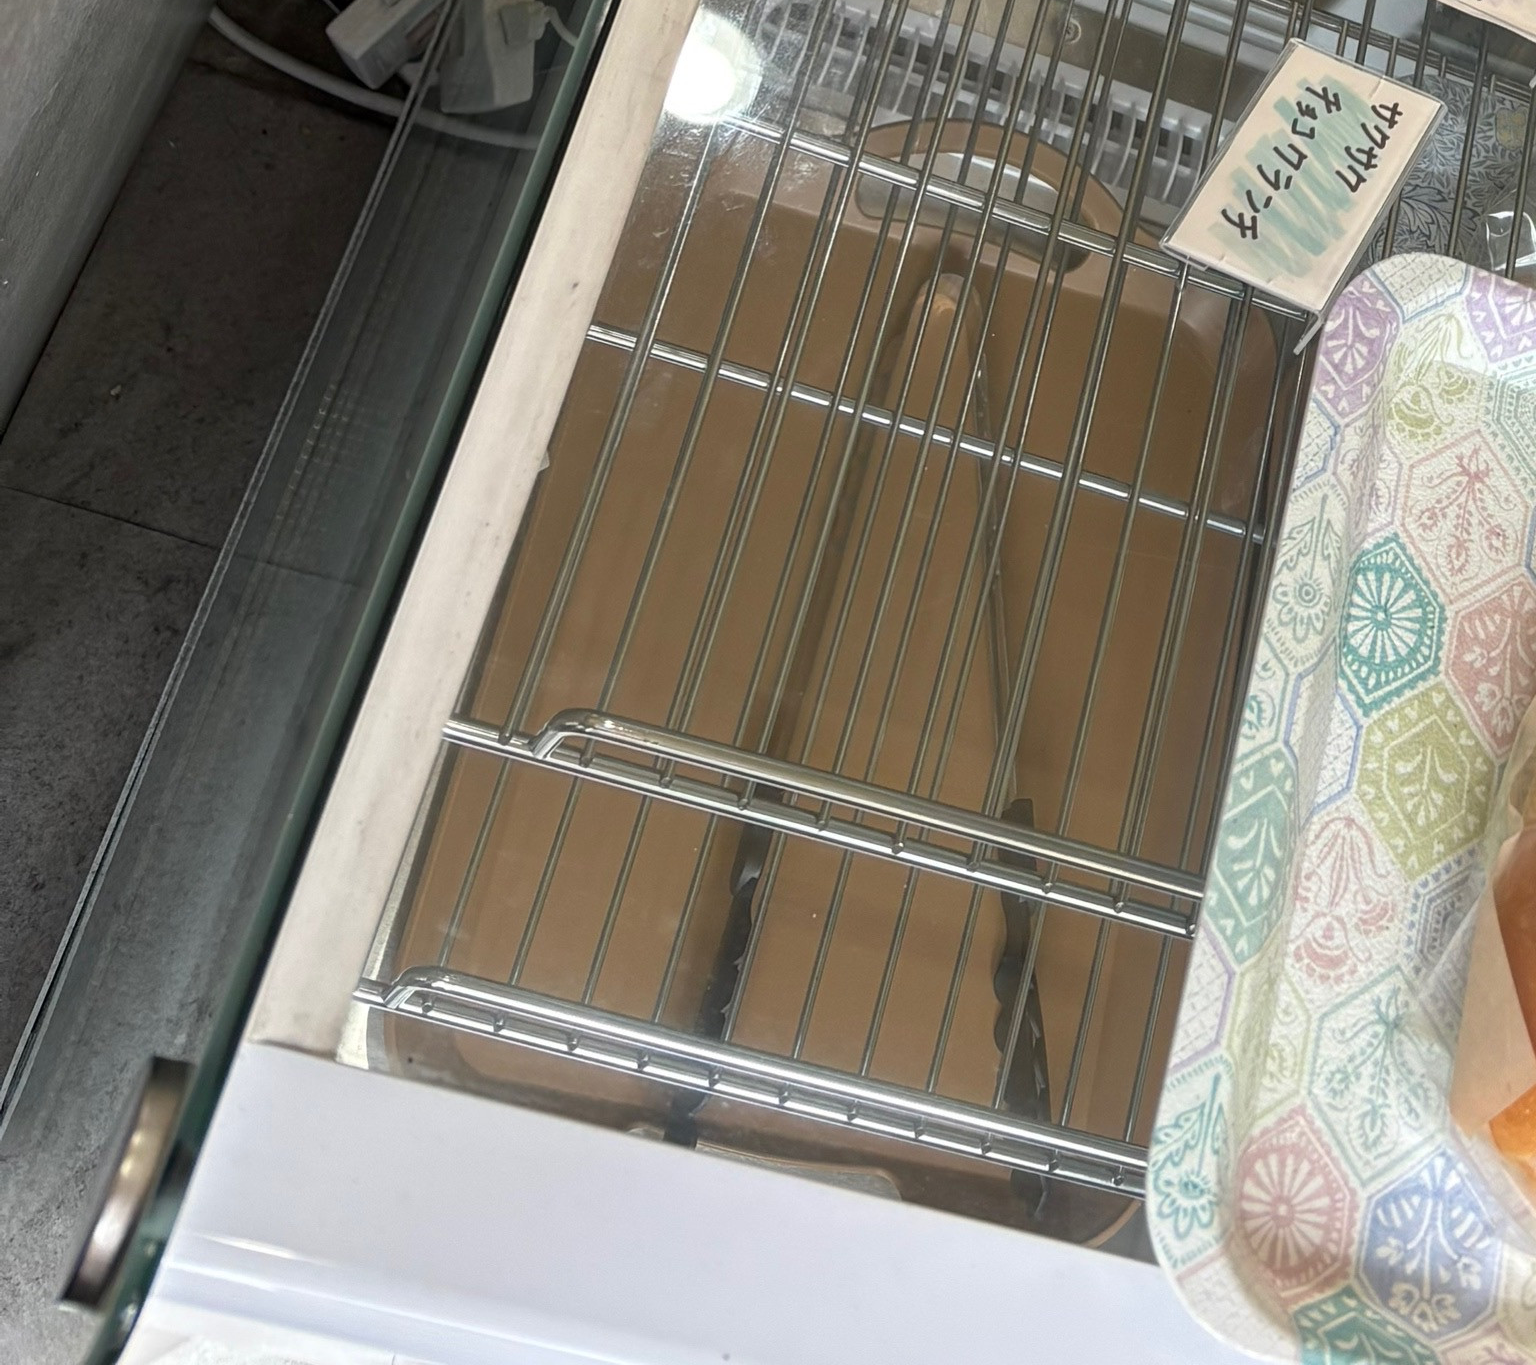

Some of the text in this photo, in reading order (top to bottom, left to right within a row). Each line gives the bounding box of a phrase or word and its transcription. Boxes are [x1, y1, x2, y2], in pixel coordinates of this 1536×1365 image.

[1221, 85, 1342, 241] チョコクランチ
[1340, 101, 1404, 193] サクサク
